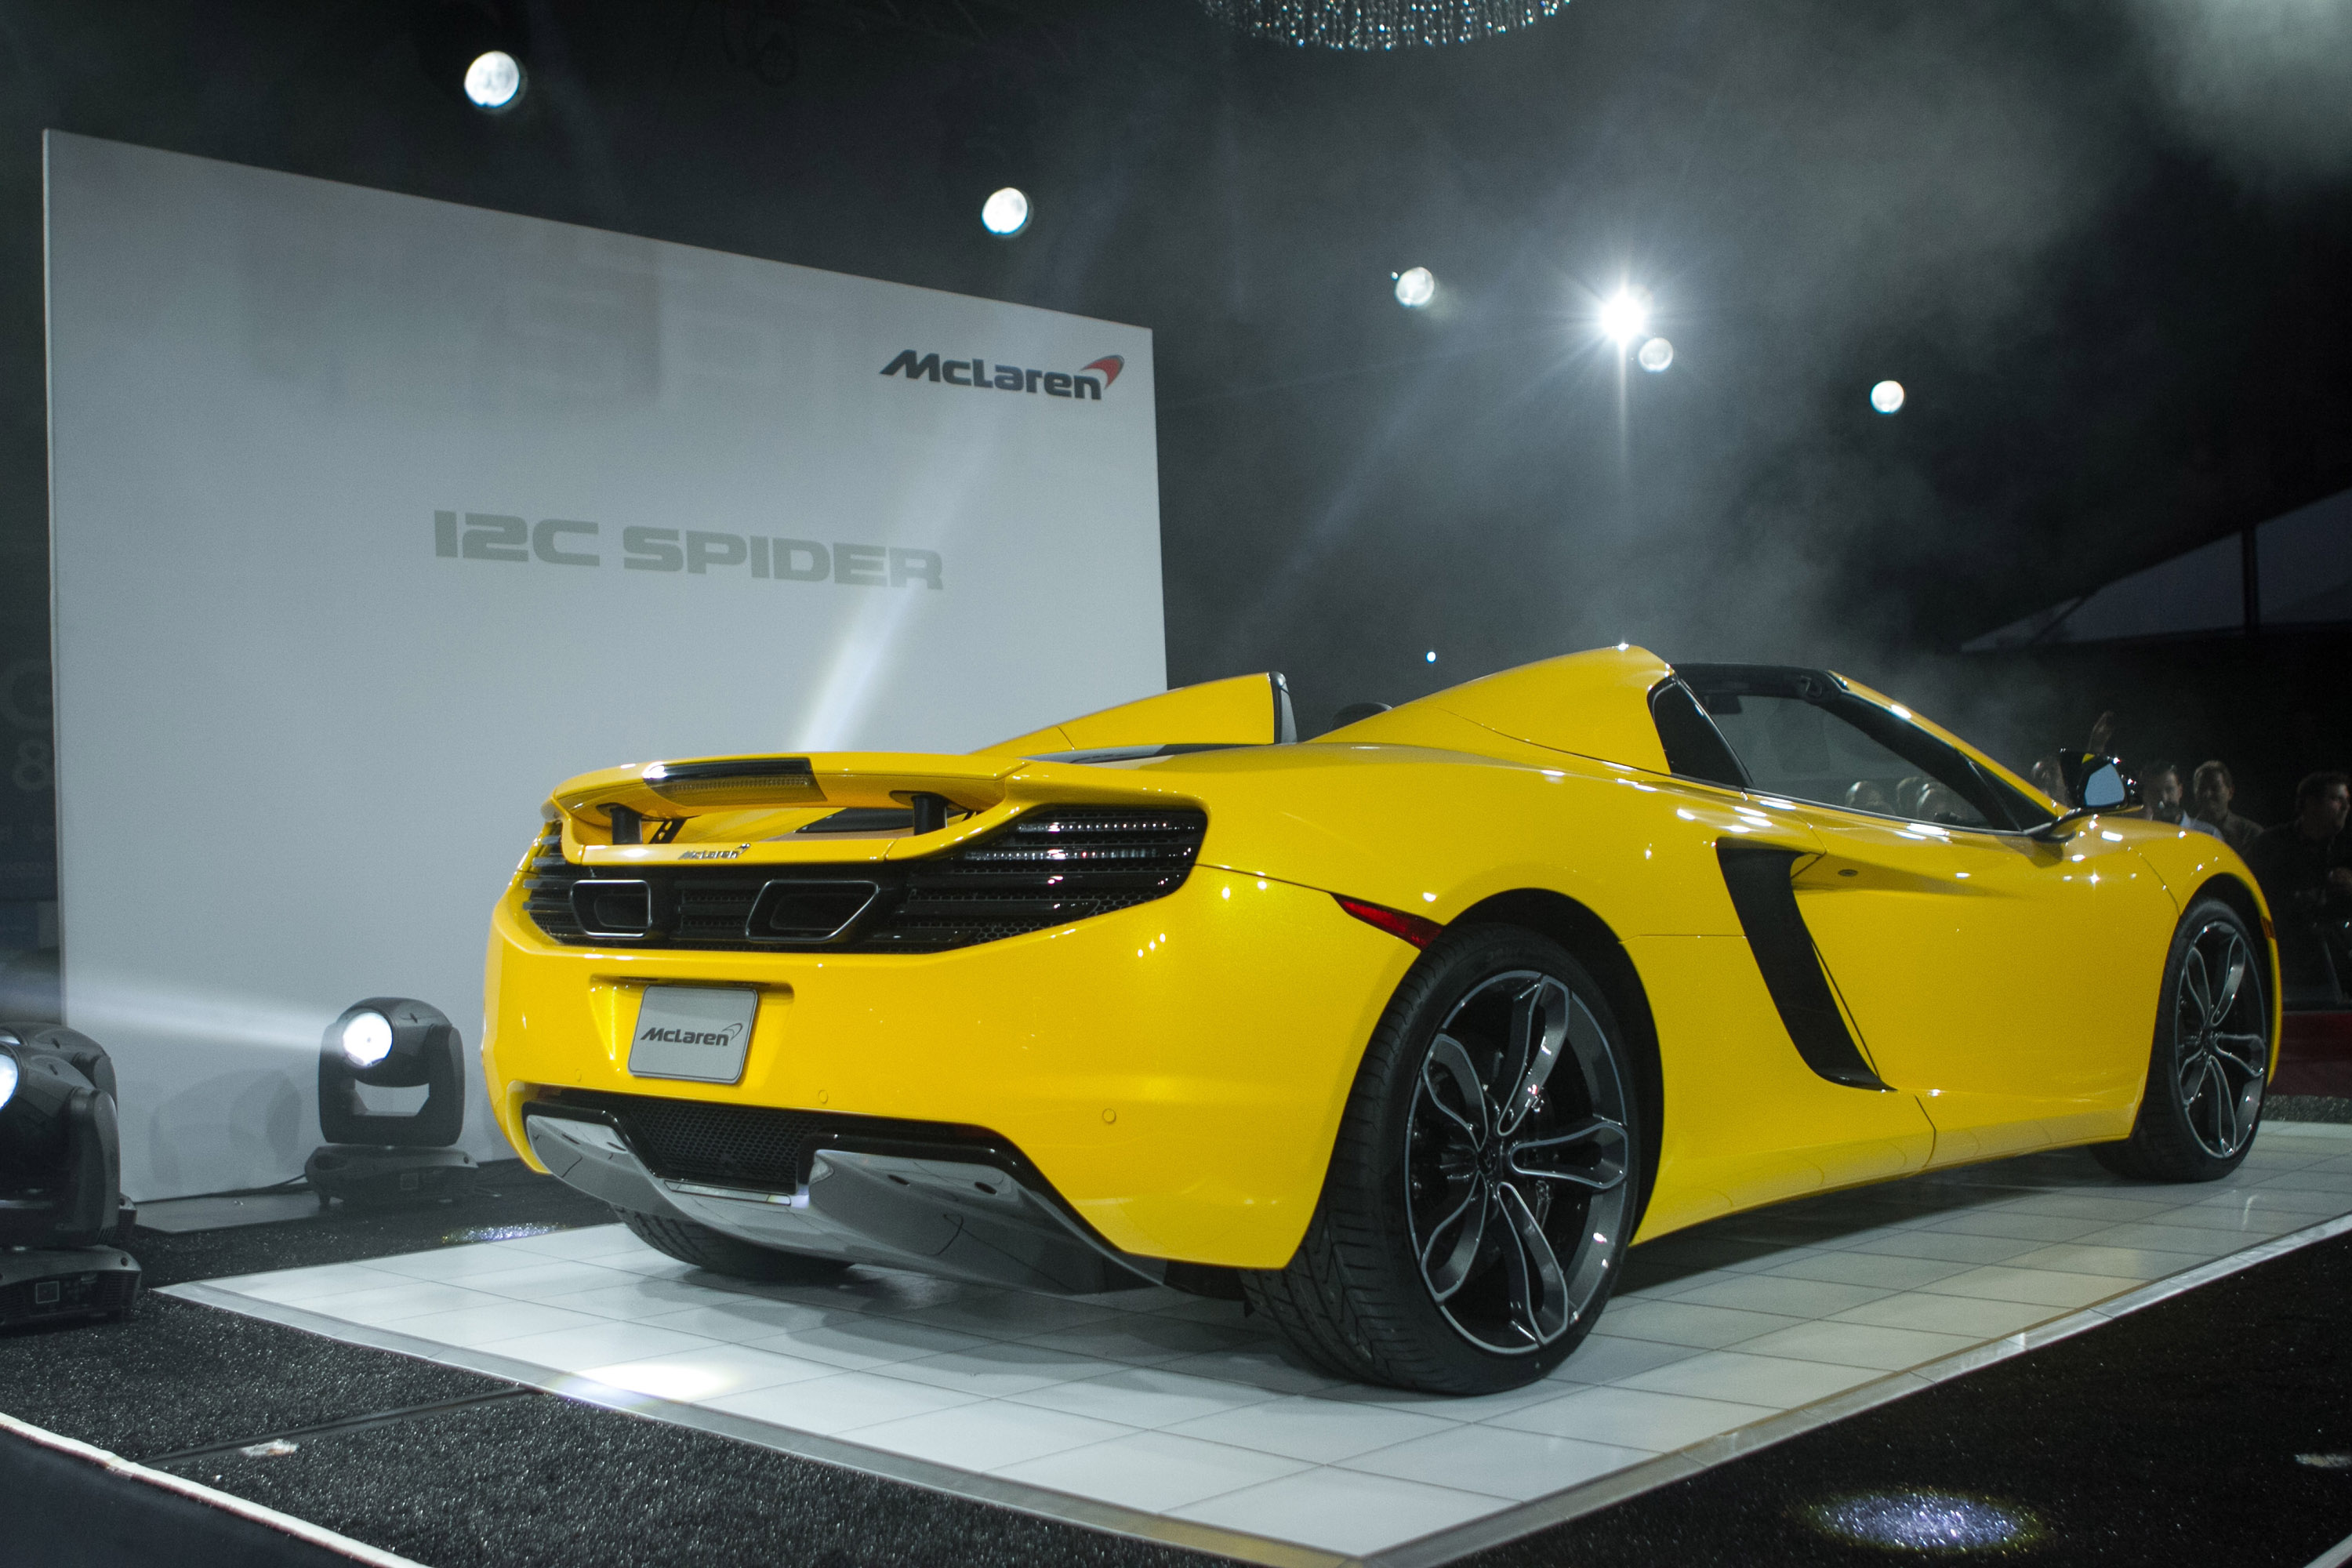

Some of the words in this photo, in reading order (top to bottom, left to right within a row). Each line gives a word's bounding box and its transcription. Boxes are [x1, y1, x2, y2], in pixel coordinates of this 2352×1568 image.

[880, 350, 1102, 400] McLaren
[622, 525, 943, 590] SPIDER
[677, 850, 739, 860] McLaren
[641, 1026, 730, 1047] McLaren
